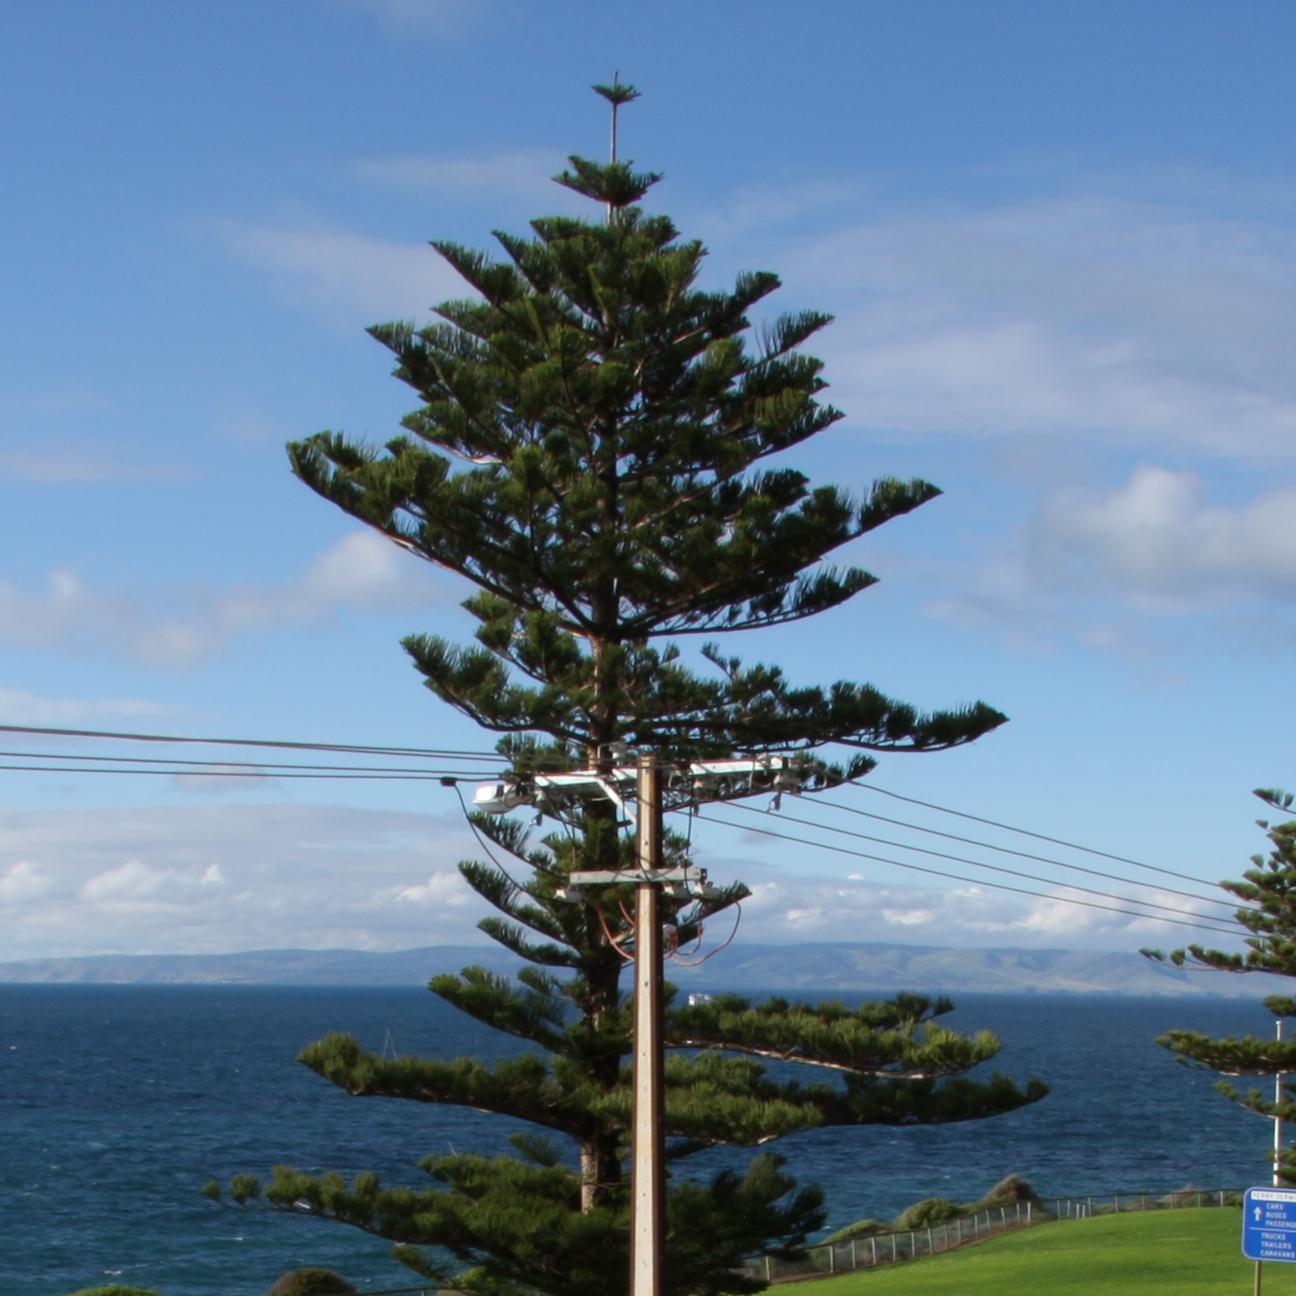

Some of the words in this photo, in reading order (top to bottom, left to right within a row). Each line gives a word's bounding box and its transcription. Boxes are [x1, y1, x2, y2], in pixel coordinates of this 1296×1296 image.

[1265, 1211, 1287, 1219] BUSES
[1261, 1232, 1286, 1240] TRUCKS
[1261, 1241, 1292, 1250] TRAILERS
[1260, 1250, 1295, 1259] CARAVANS
